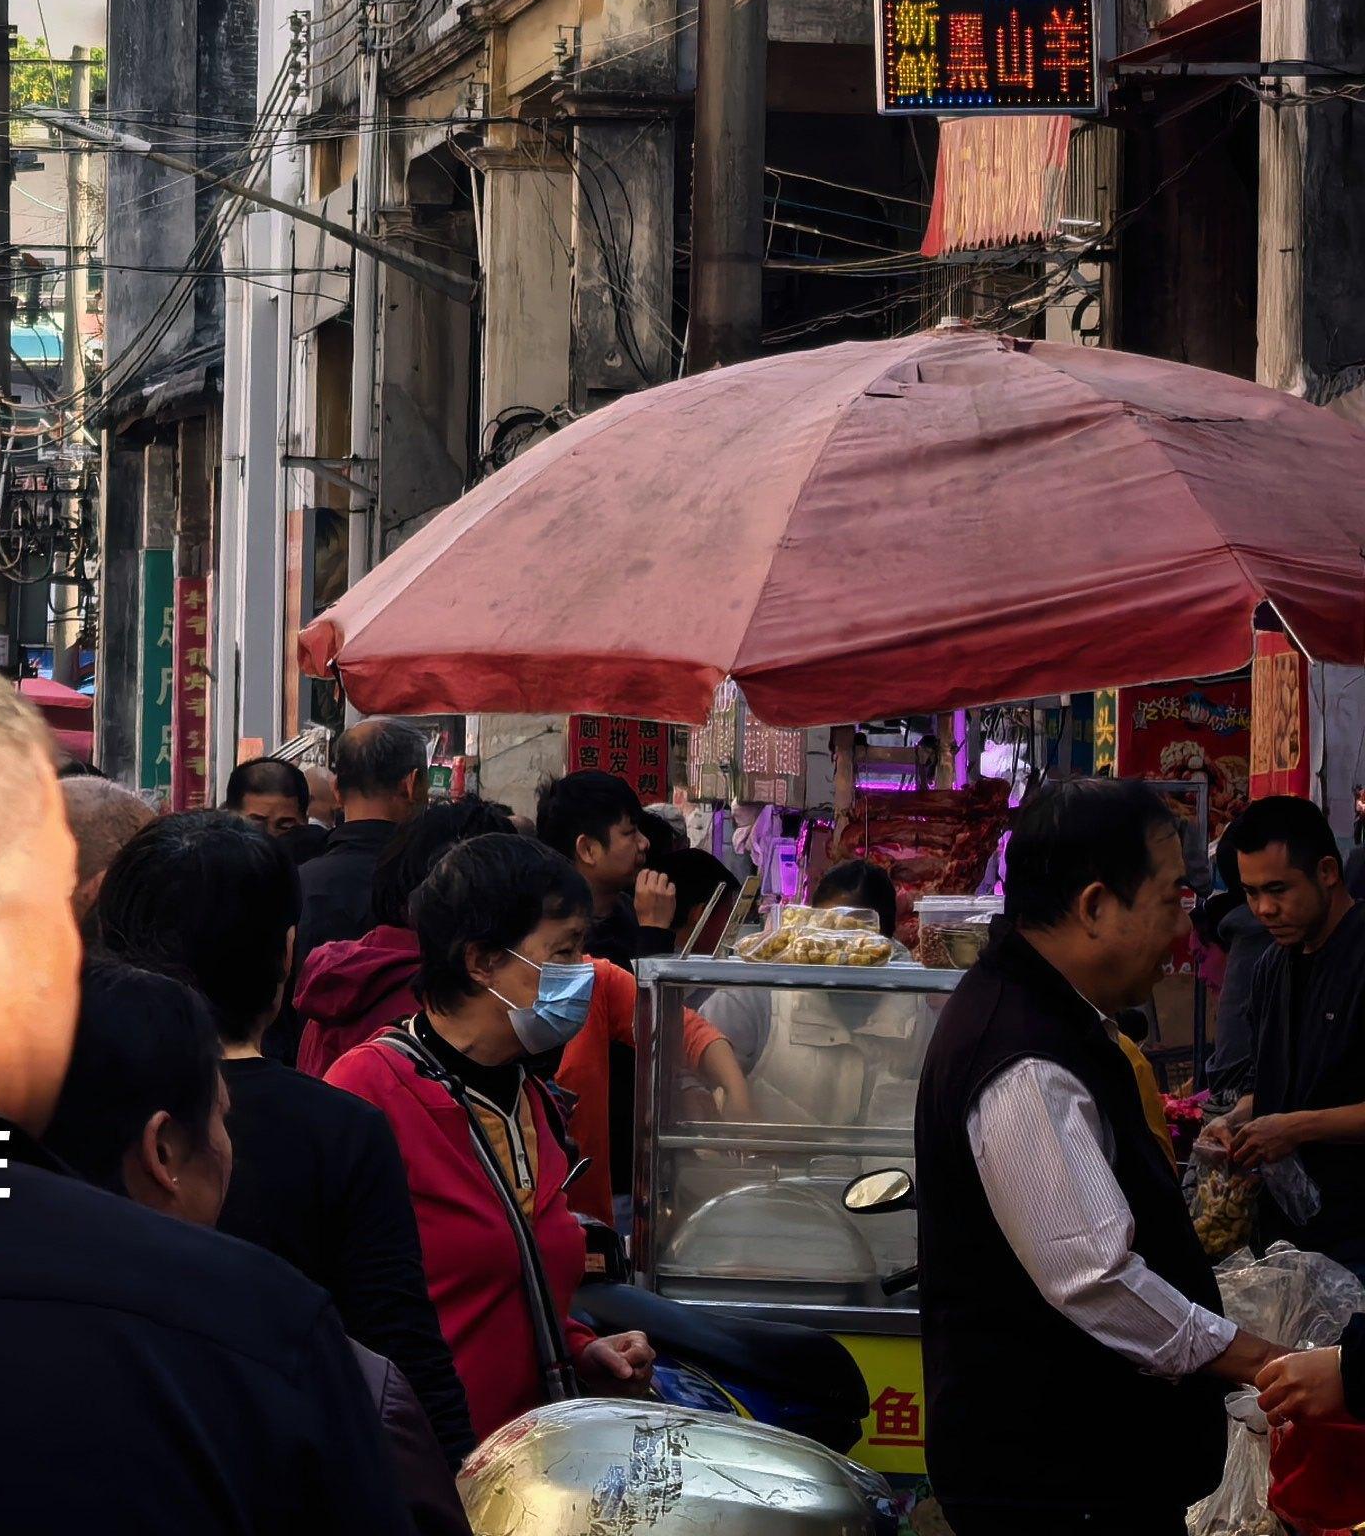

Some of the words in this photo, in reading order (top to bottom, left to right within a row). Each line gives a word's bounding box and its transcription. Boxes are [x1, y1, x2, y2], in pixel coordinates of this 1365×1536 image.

[946, 7, 1089, 92] 黑山羊
[870, 1385, 921, 1436] 鱼
